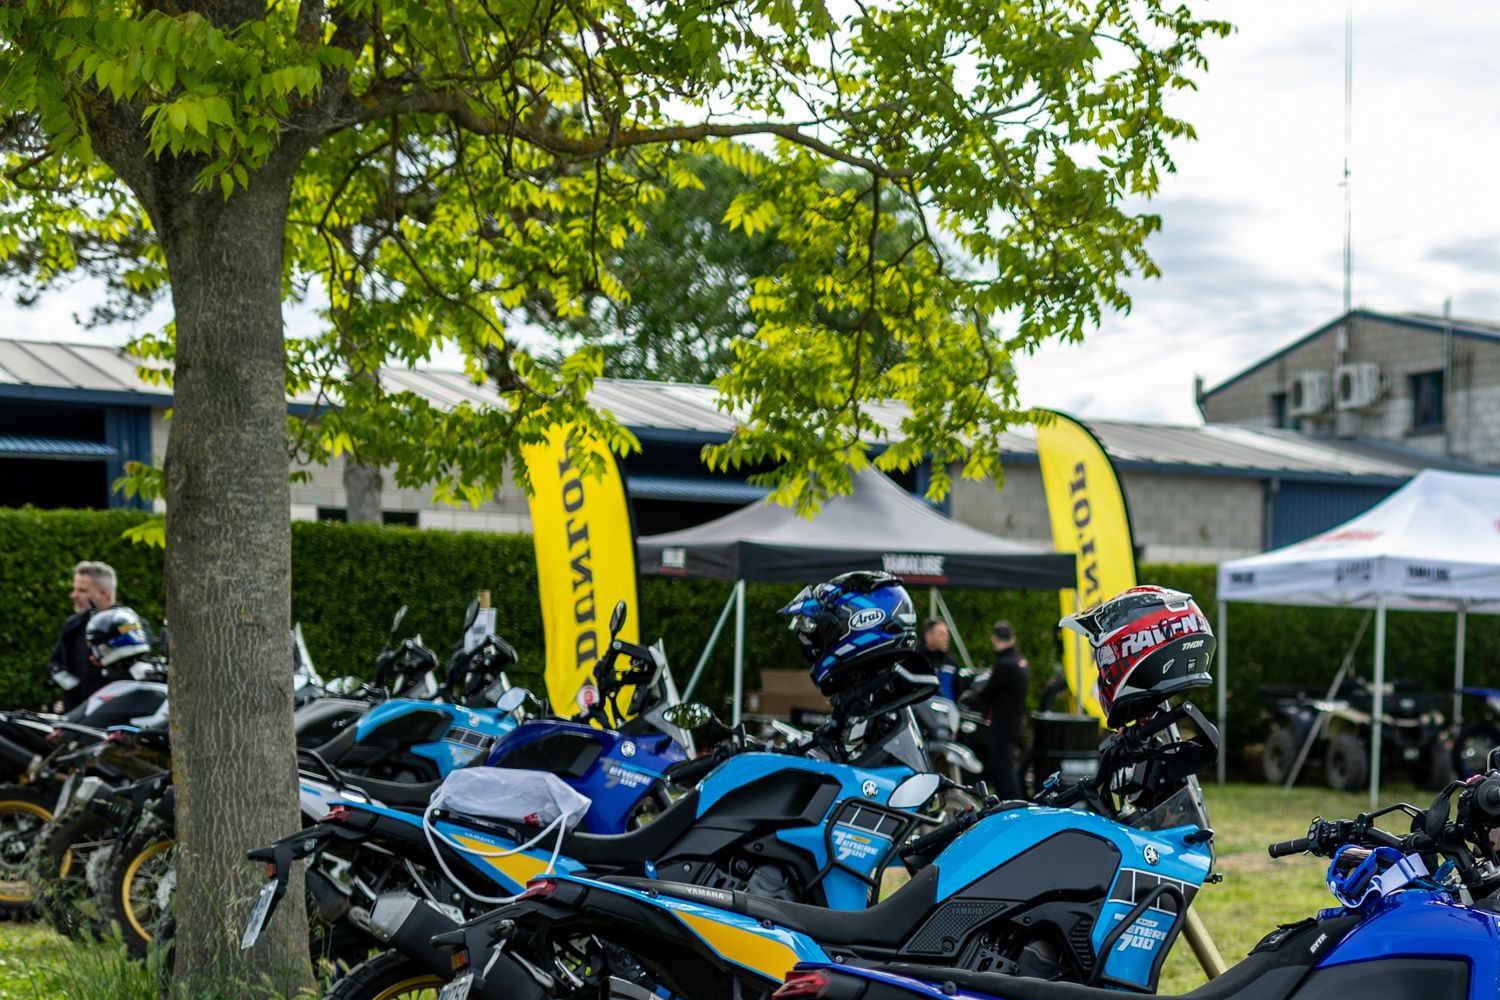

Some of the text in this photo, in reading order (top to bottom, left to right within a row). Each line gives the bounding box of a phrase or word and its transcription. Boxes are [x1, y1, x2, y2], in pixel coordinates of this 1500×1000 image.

[853, 610, 881, 628] Arai
[1182, 640, 1204, 651] THOR
[686, 886, 724, 900] YAMAHA
[951, 907, 983, 915] YAMAHA
[1117, 934, 1155, 952] 700
